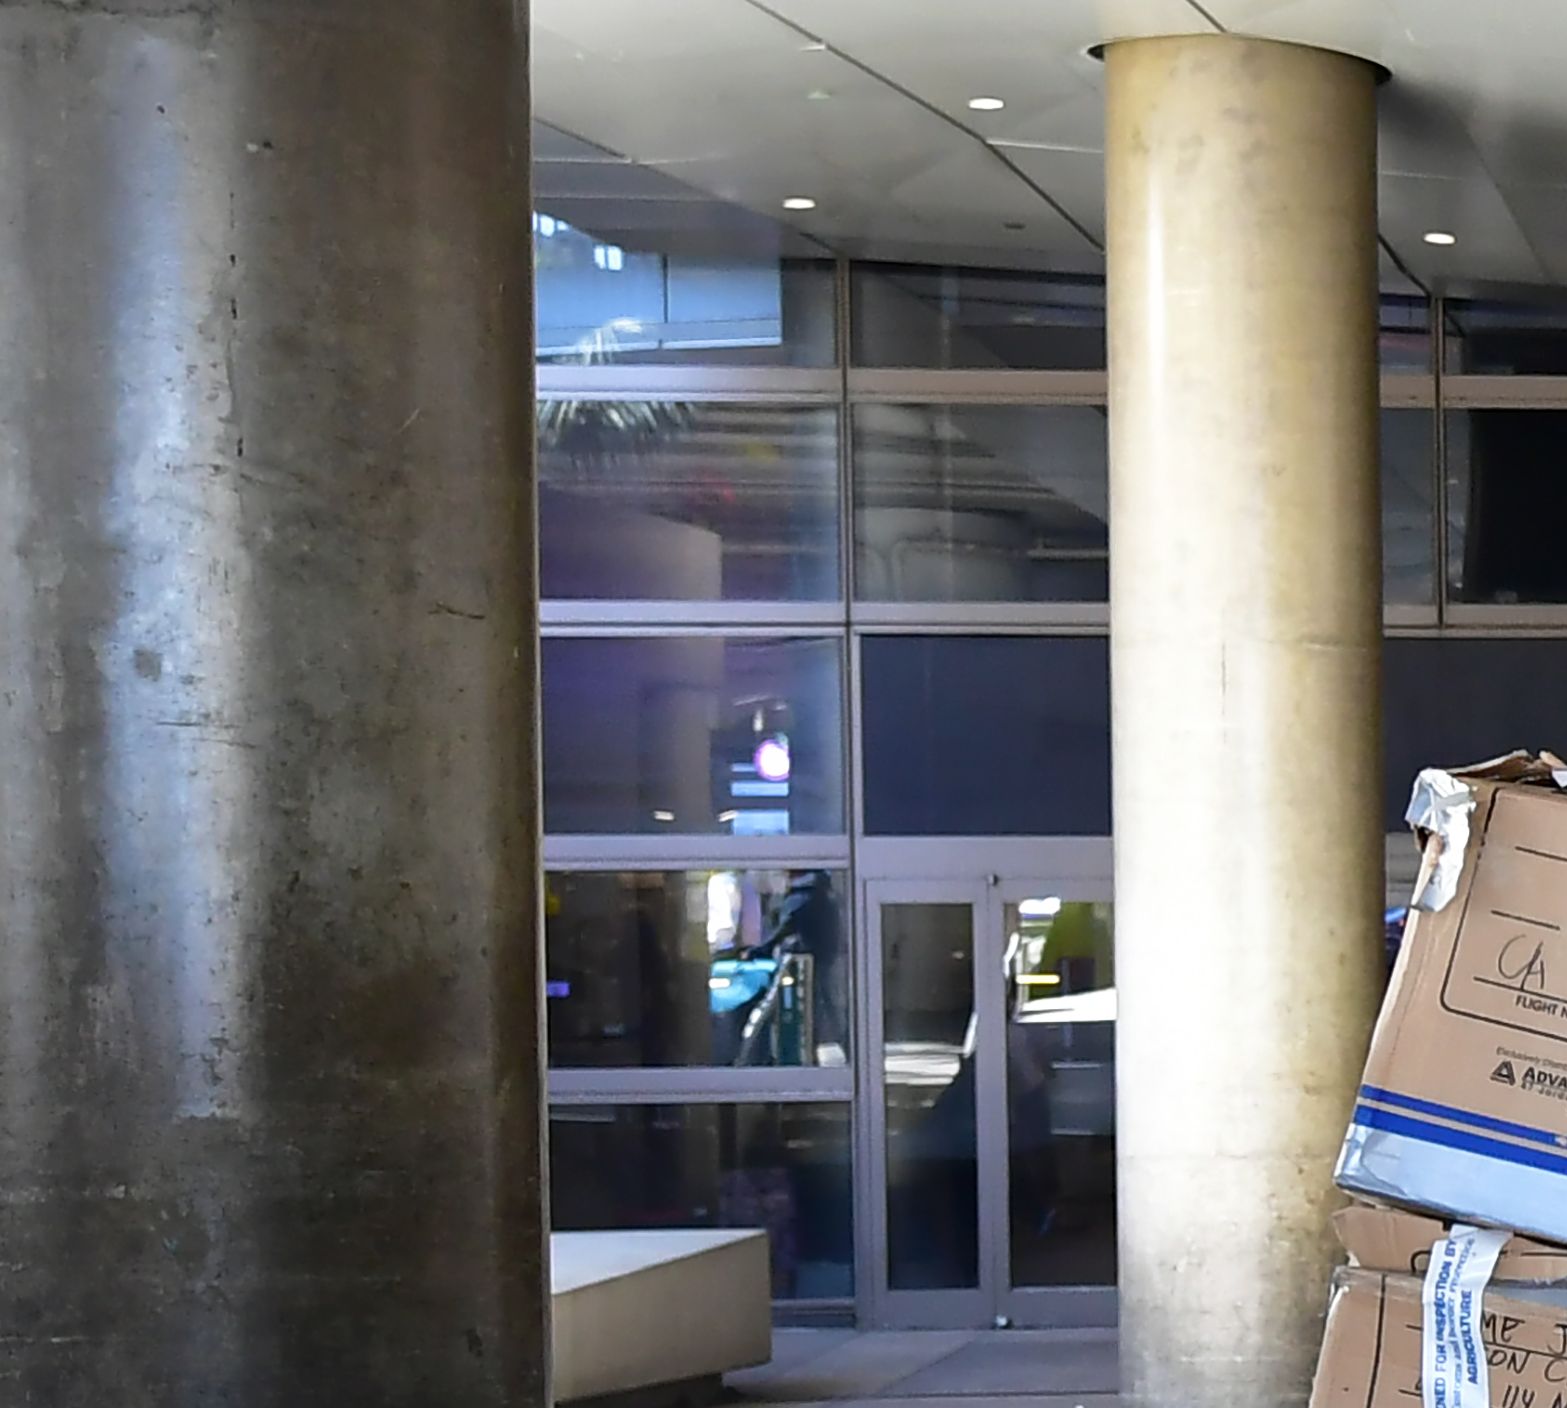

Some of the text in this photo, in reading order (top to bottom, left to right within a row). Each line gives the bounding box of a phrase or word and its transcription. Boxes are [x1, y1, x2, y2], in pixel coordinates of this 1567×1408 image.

[1515, 994, 1558, 1016] FLIGHT
[1444, 1237, 1457, 1257] BY
[1433, 1261, 1453, 1342] INSPECTION
[1460, 1289, 1478, 1385] AGRICULTURE
[1434, 1342, 1448, 1373] FOR
